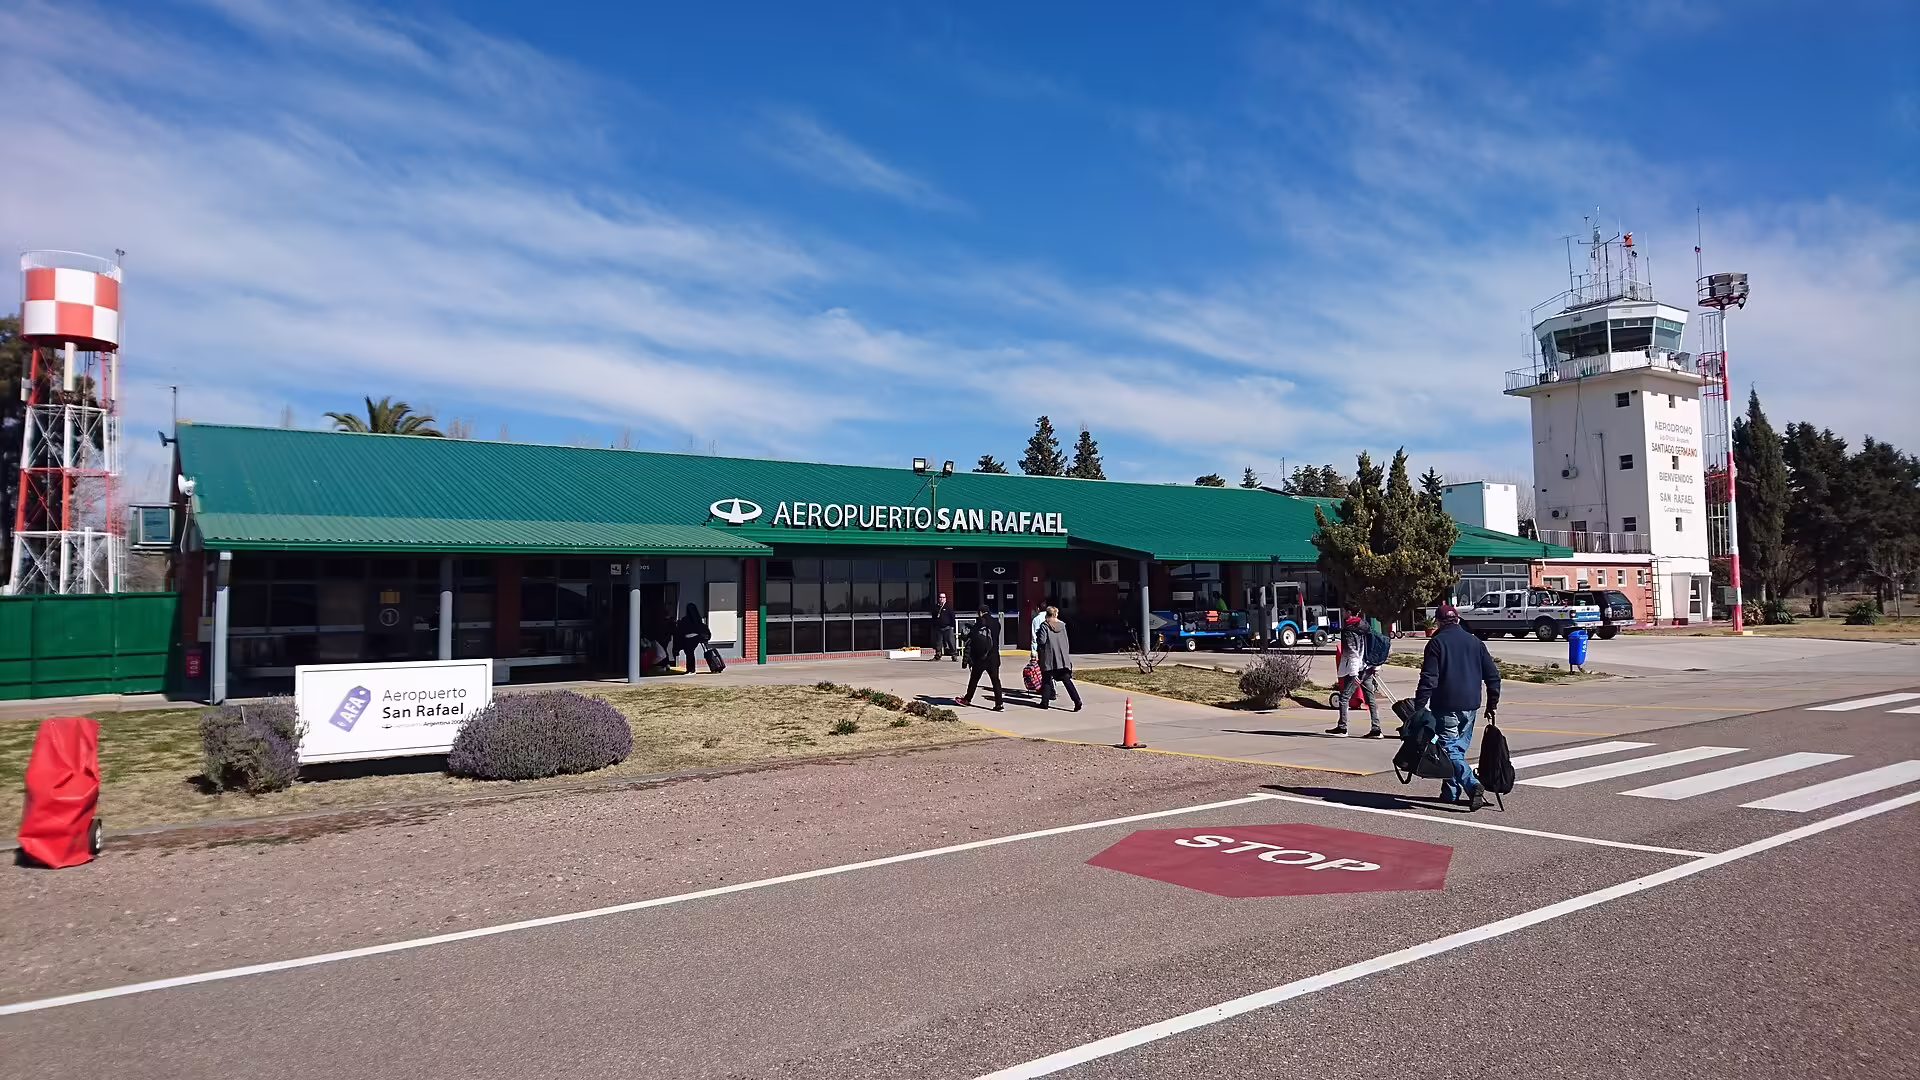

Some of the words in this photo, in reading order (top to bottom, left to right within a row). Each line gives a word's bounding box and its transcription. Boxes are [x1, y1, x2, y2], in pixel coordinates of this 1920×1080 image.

[1655, 421, 1693, 435] AERODROMO
[1651, 443, 1674, 454] SANTIAGO
[1675, 446, 1697, 457] GERMANO
[1659, 471, 1694, 484] BIENVENIDOS
[1675, 484, 1679, 492] A
[1660, 492, 1671, 502] SAN
[1673, 493, 1695, 504] RAFAEL
[773, 501, 932, 529] AEROPUERTO
[936, 508, 983, 530] SAN
[991, 510, 1068, 534] RAFAEL
[382, 687, 467, 703] Aeropuerto
[340, 696, 365, 724] AFA
[382, 706, 411, 719] San
[416, 702, 464, 717] Rafael
[1174, 835, 1381, 871] STOP
